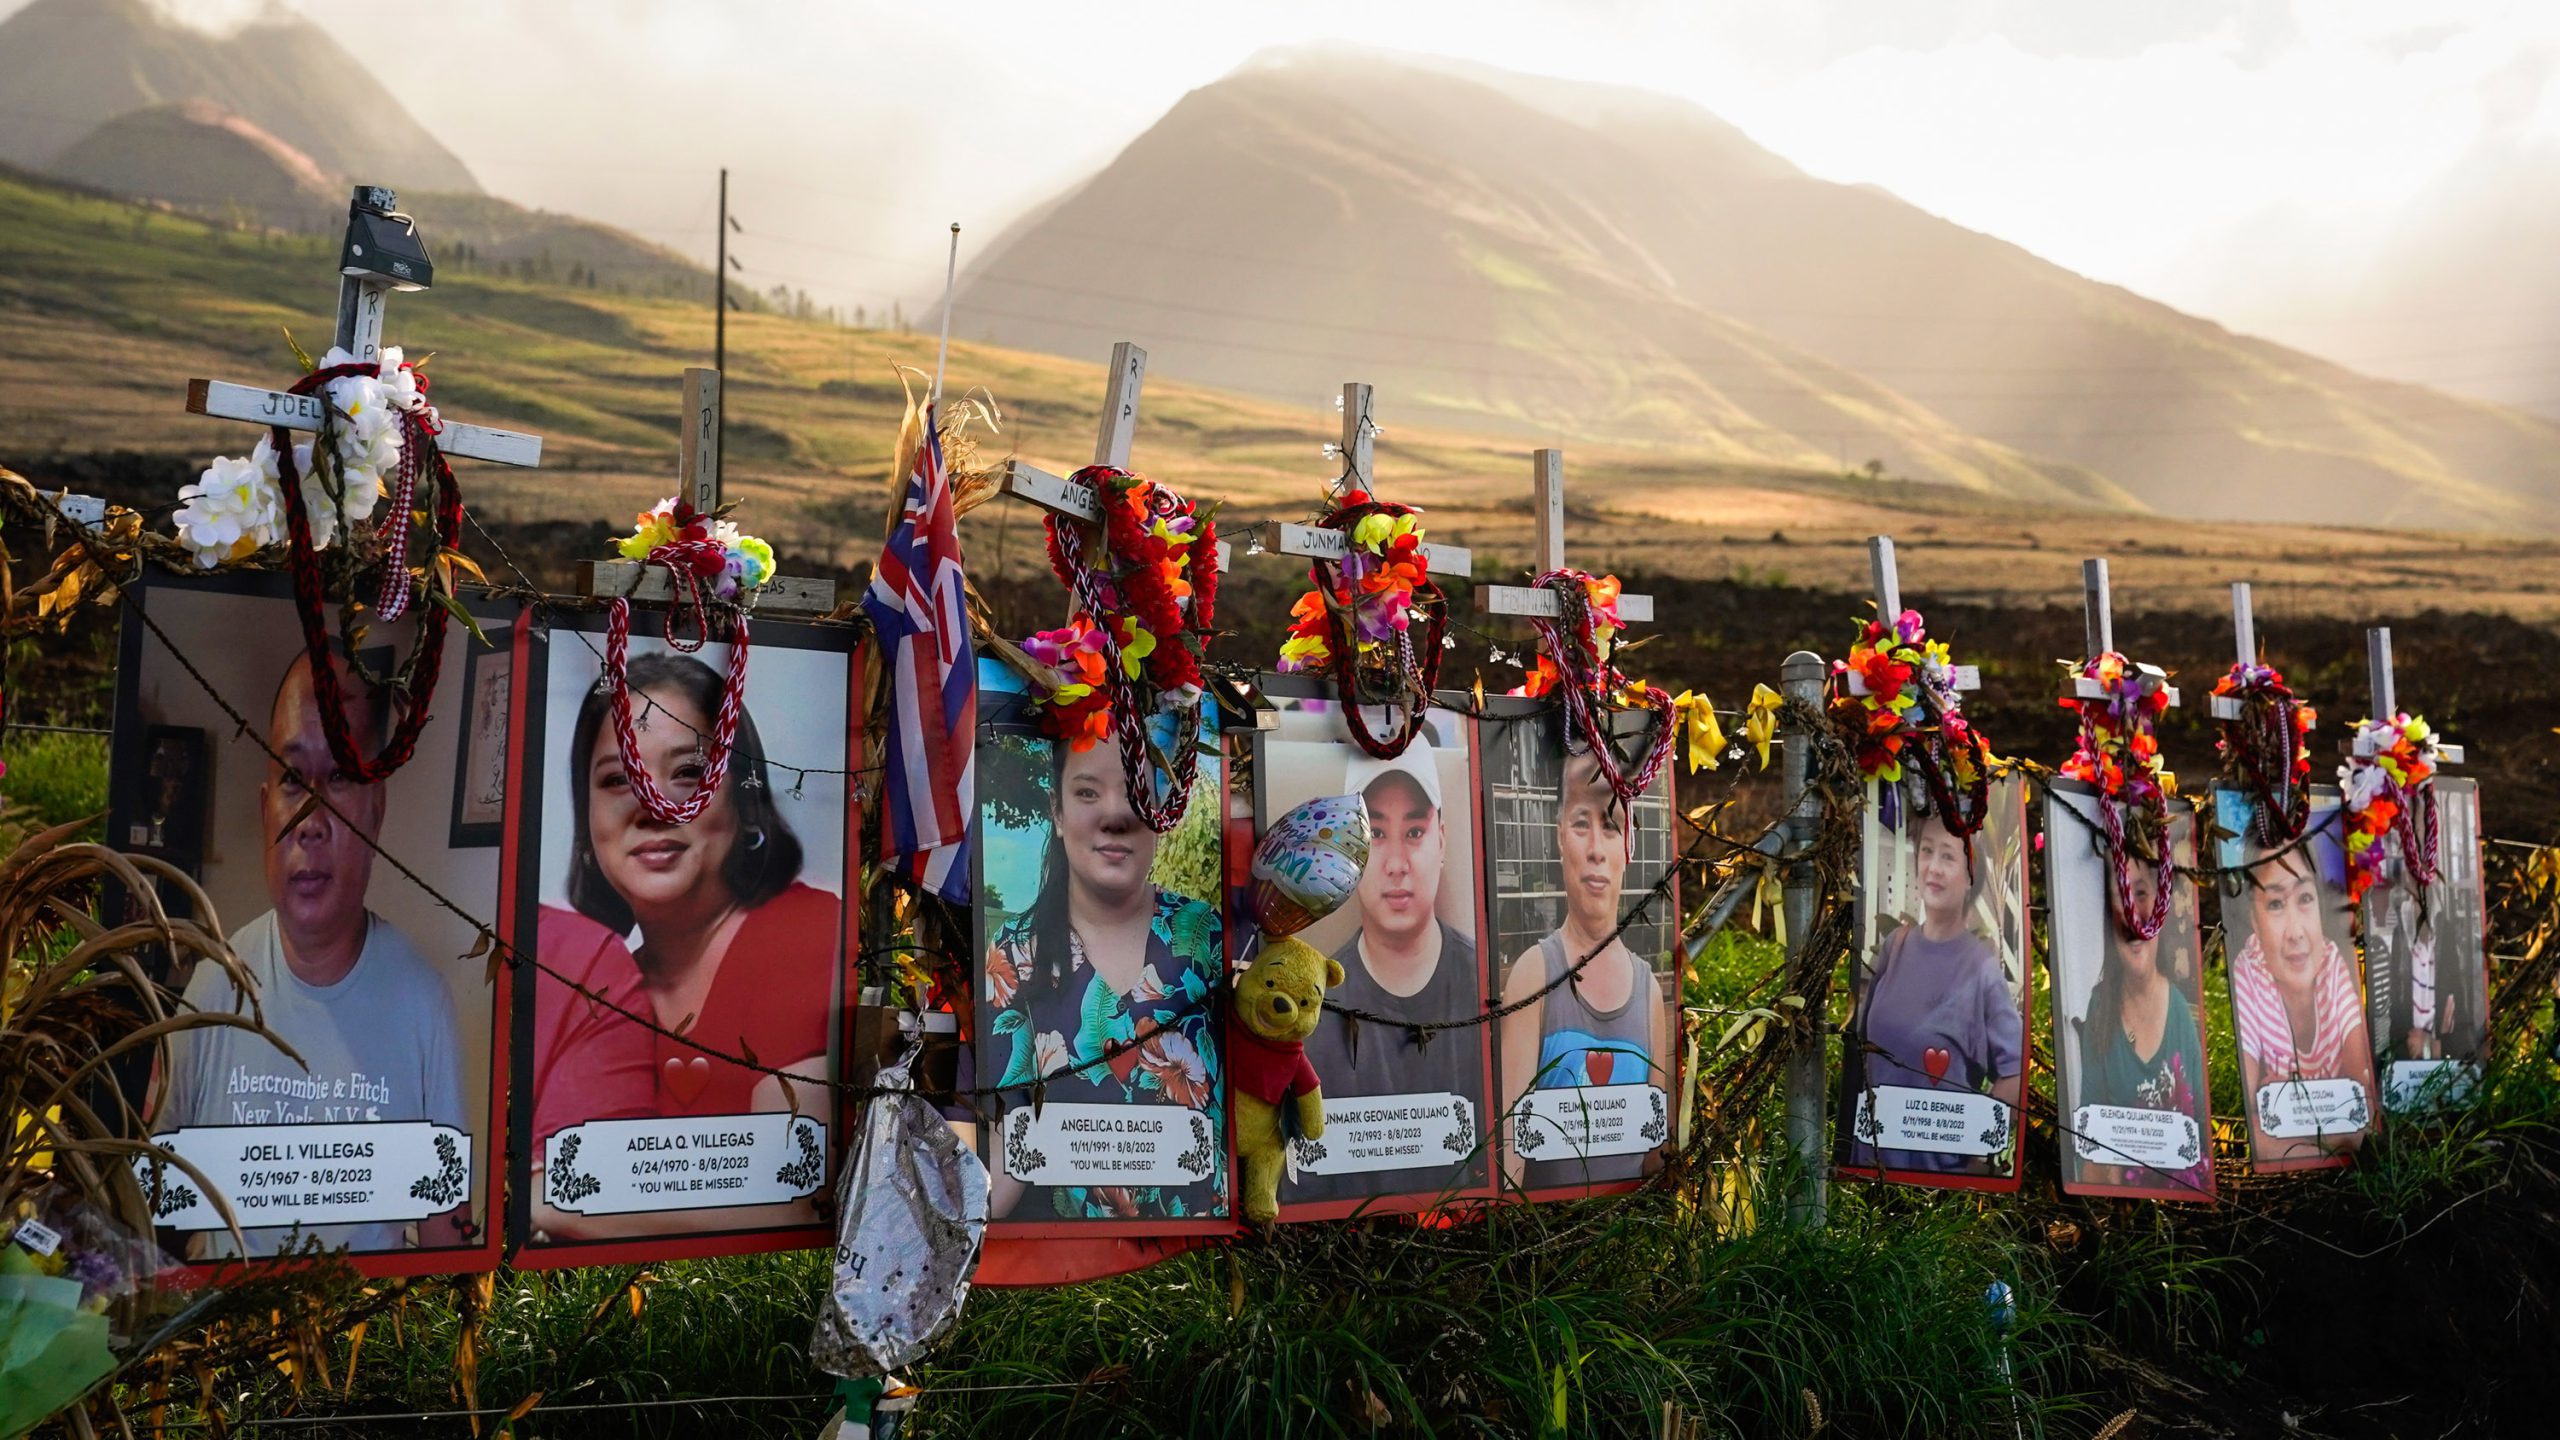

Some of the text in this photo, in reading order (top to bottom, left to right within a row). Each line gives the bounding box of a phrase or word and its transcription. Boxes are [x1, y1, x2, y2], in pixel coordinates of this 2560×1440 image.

[364, 290, 379, 360] RIP
[1123, 357, 1138, 421] RIP
[262, 392, 321, 419] JOEL
[700, 407, 712, 512] RIP
[1060, 484, 1096, 512] ANGE
[227, 1065, 389, 1104] Abercrombie & Fitch
[232, 1101, 271, 1124] New
[1559, 1098, 1627, 1113] FELIMN QUIJANO
[1905, 1099, 1921, 1110] LUZ
[1930, 1101, 1965, 1114] BERNABE
[1364, 1108, 1408, 1122] GEOVANIE
[1410, 1106, 1449, 1120] QUIJANO
[1060, 1119, 1112, 1132] ANGELICA
[1127, 1121, 1163, 1133] BACLIG
[1595, 1117, 1623, 1129] 8/8/2023
[1936, 1118, 1965, 1129] 8/8/2023
[627, 1132, 755, 1152] ADELA Q. VILLEGAS
[1349, 1130, 1382, 1143] 7/2/1993
[1388, 1128, 1421, 1140] 8/8/2023
[1593, 1134, 1599, 1143] BE
[1917, 1131, 1930, 1140] WILL
[1931, 1132, 1939, 1140] BE
[240, 1142, 374, 1161] JOEL I. VILLEGAS
[1070, 1140, 1111, 1153] 11/11/1991
[1117, 1140, 1155, 1153] 8/8/2023
[1367, 1147, 1384, 1156] WILL
[1385, 1146, 1393, 1156] BE
[632, 1159, 689, 1175] 6/24/1970
[699, 1156, 749, 1172] 8/8/2023
[1092, 1161, 1110, 1170] WILL
[1112, 1161, 1121, 1170] BE
[240, 1171, 300, 1188] 9/5/1967
[311, 1168, 371, 1185] 8/8/2023
[664, 1181, 687, 1191] WILL
[690, 1180, 703, 1190] BE
[272, 1194, 301, 1206] WILL
[304, 1193, 319, 1205] BE
